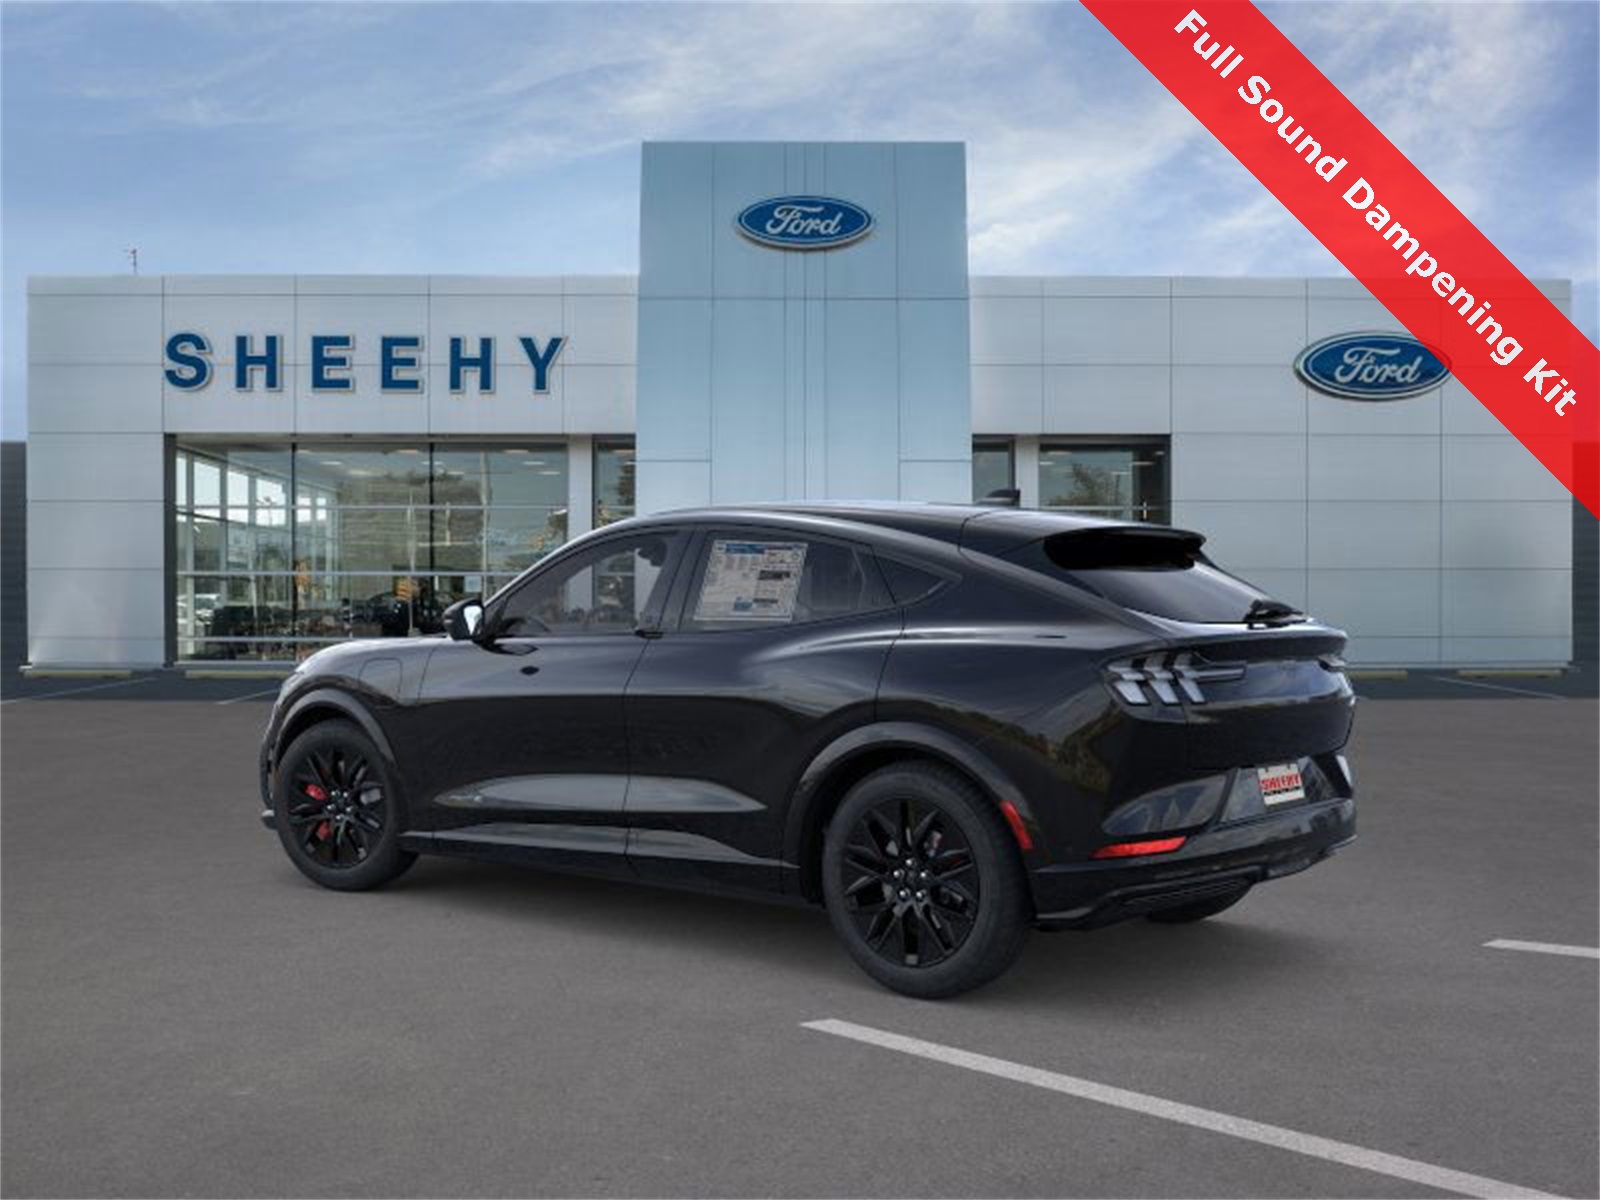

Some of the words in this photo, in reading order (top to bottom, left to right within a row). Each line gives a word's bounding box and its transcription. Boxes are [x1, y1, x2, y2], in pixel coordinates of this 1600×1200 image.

[765, 204, 844, 235] Ford
[164, 332, 567, 393] SHEEHY
[1333, 346, 1424, 383] Ford
